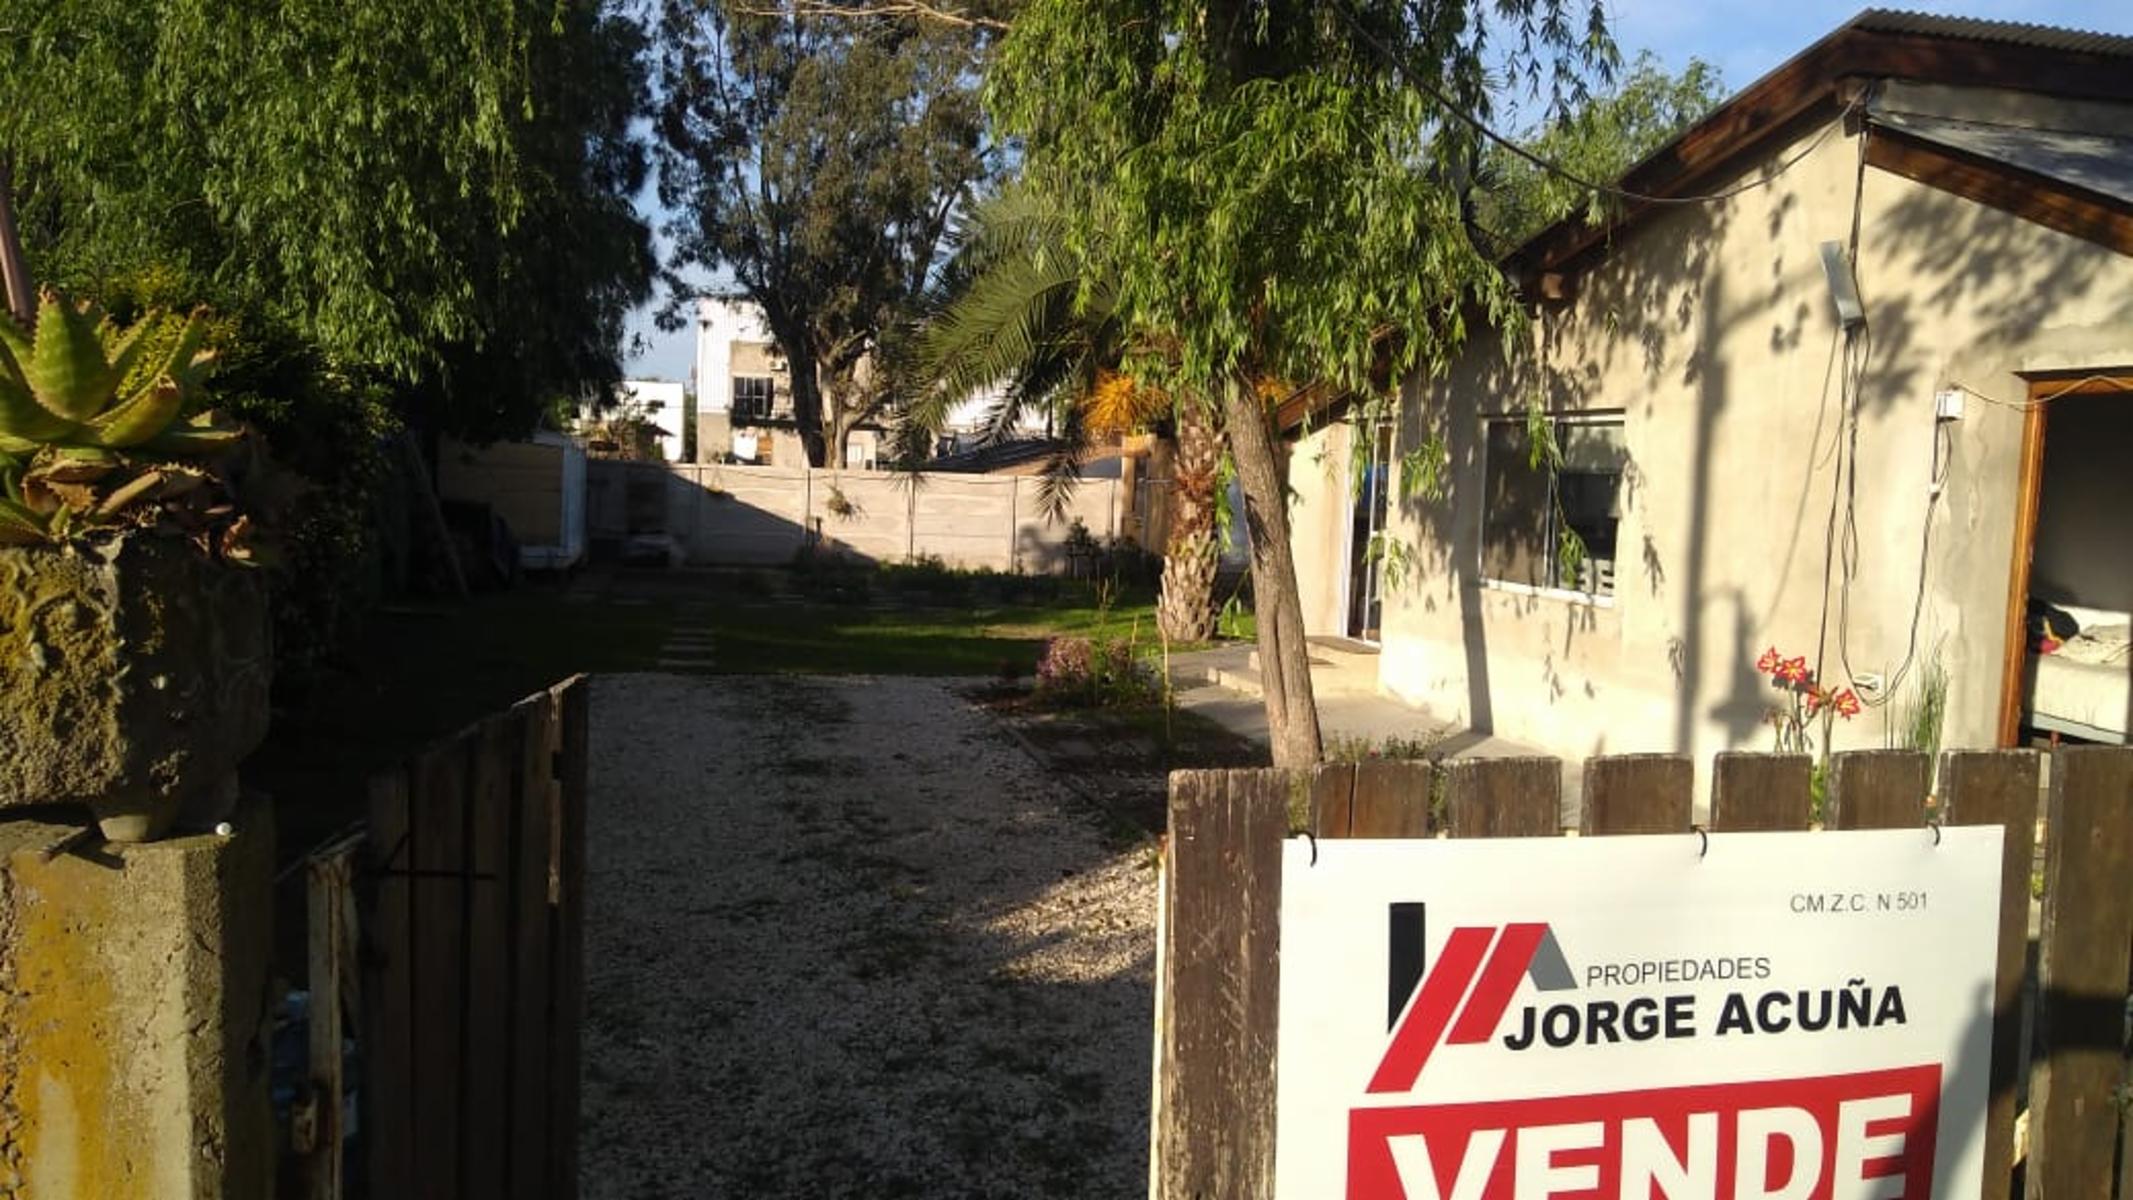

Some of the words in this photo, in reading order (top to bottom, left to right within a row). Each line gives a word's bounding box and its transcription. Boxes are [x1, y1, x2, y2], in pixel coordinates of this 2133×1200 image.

[1877, 893, 1891, 911] N
[1897, 891, 1927, 911] 501
[1586, 957, 1771, 987] PROPIEDADES
[1503, 995, 1696, 1051] JORGE
[1715, 977, 1907, 1036] ACUÑA
[1386, 1092, 1913, 1200] VENDE
